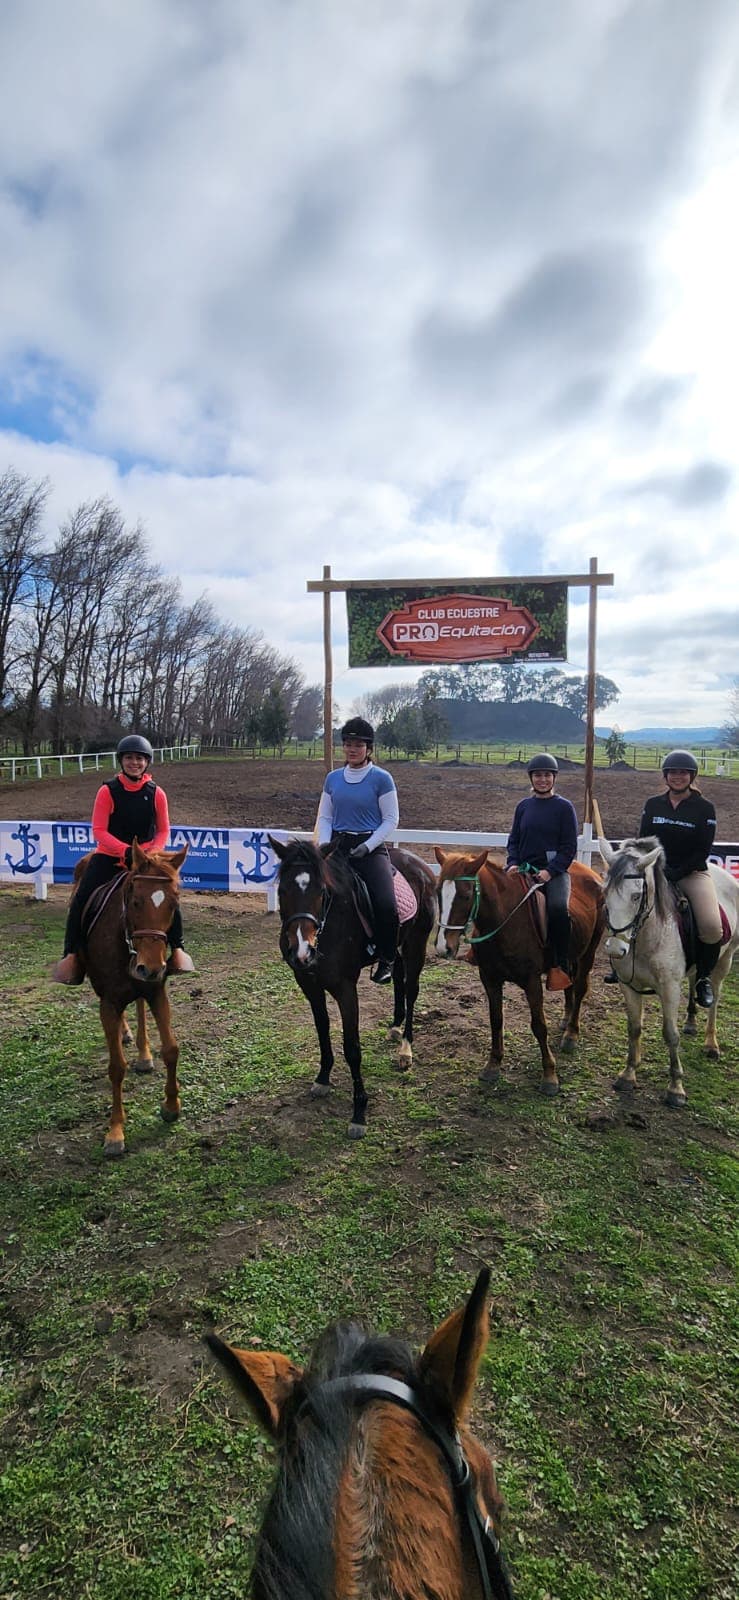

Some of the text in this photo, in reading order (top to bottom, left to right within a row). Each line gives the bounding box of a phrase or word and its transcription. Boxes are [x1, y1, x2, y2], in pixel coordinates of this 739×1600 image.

[418, 607, 500, 620] CLUB ECUESTRE
[439, 624, 526, 639] Equitación
